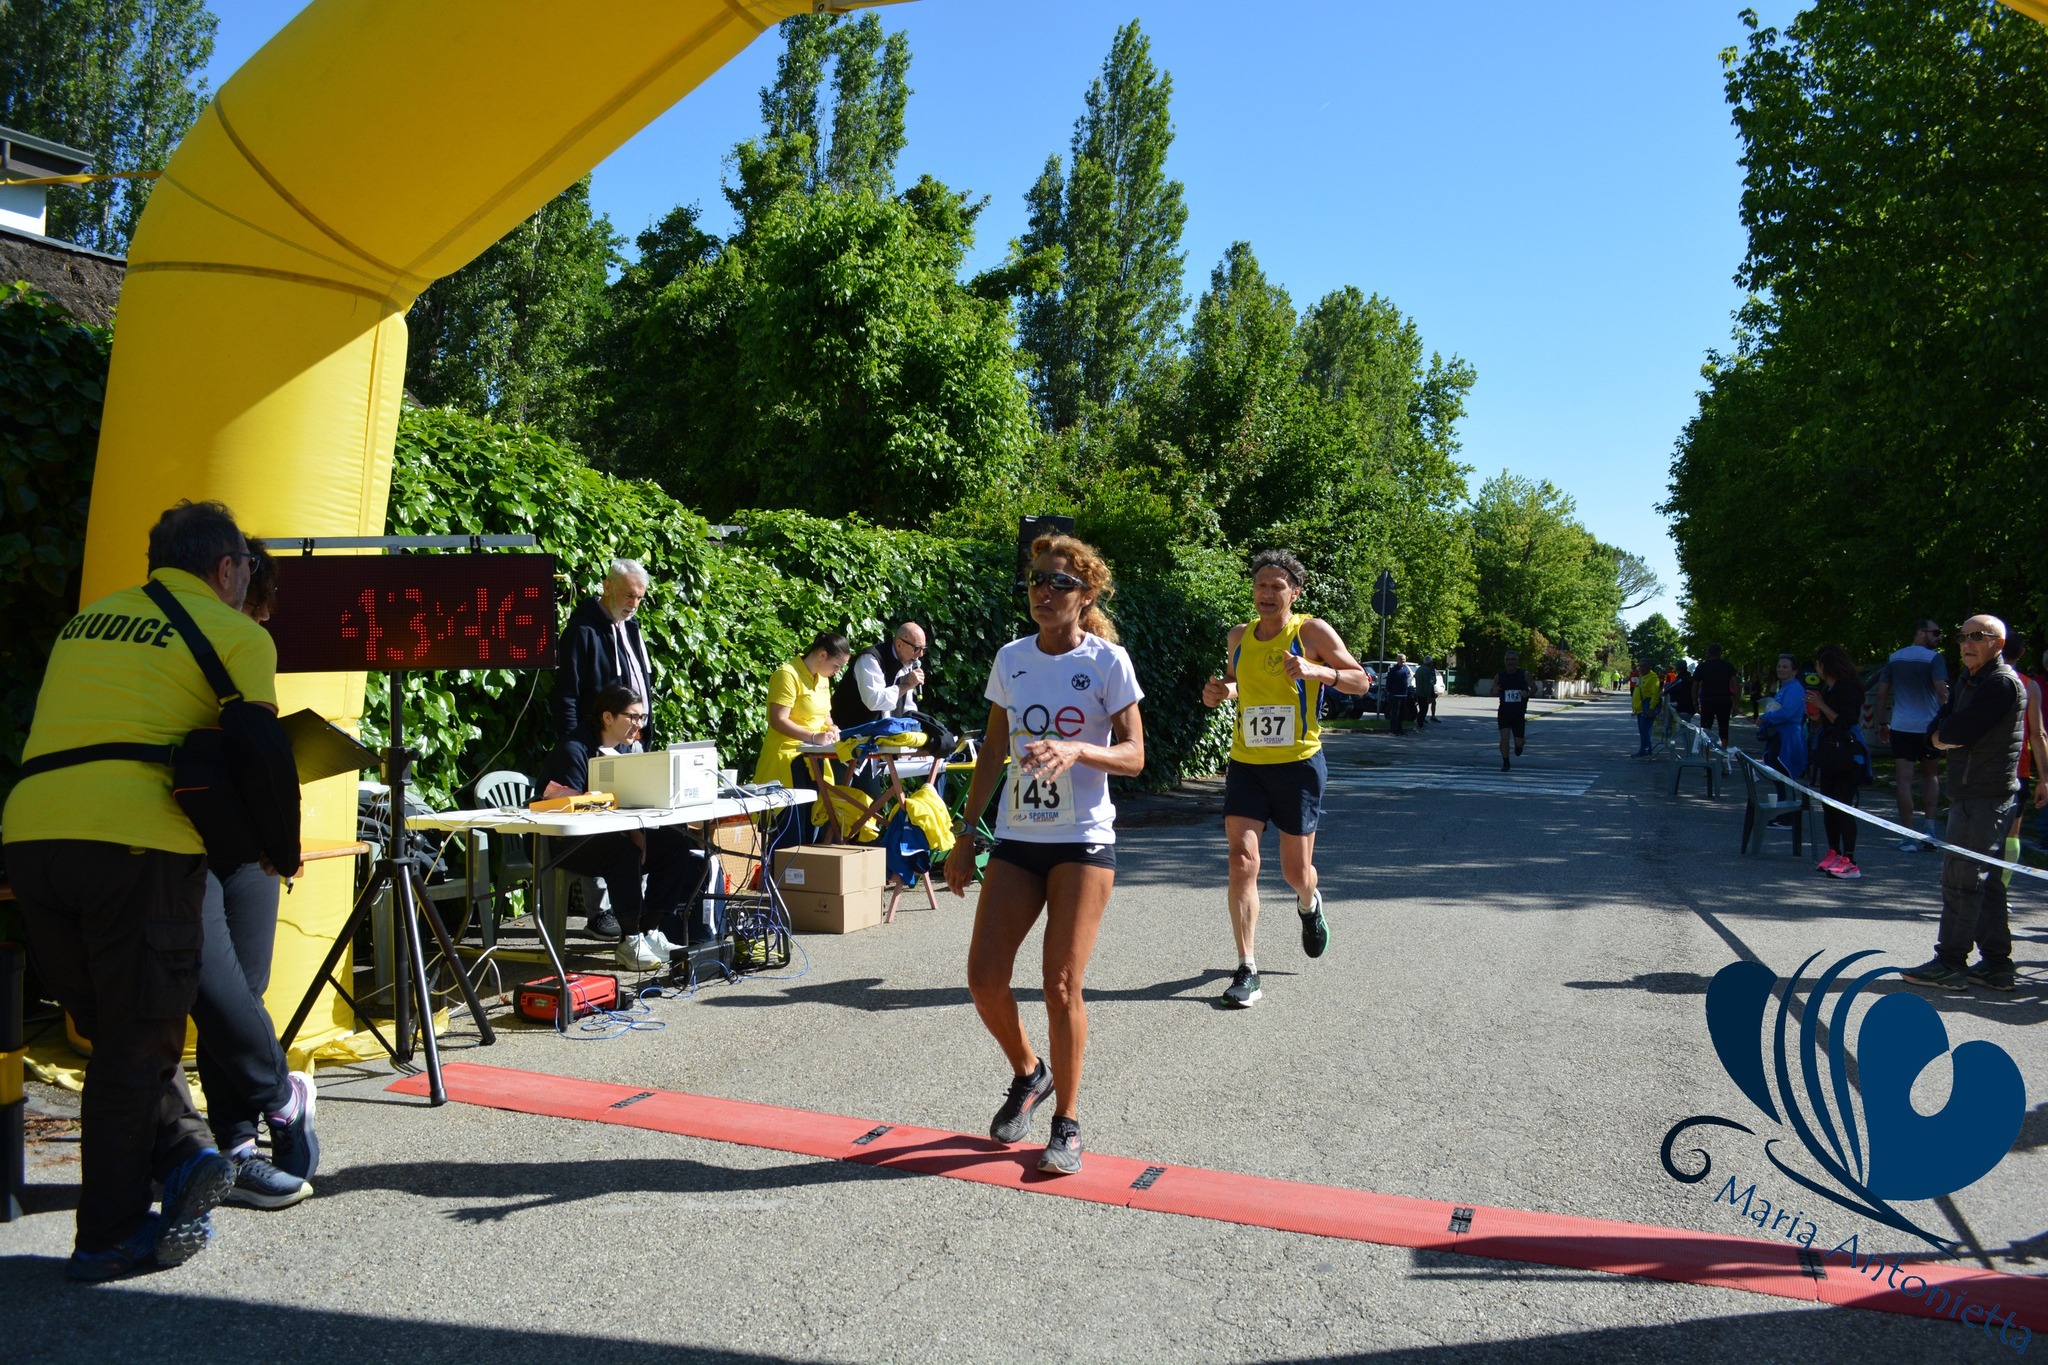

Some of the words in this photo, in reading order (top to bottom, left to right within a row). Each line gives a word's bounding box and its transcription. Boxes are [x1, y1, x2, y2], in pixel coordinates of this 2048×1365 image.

[61, 613, 175, 648] GIUDICE
[1250, 716, 1286, 736] 137
[1013, 779, 1060, 809] 143
[1029, 811, 1059, 819] SPORTGM
